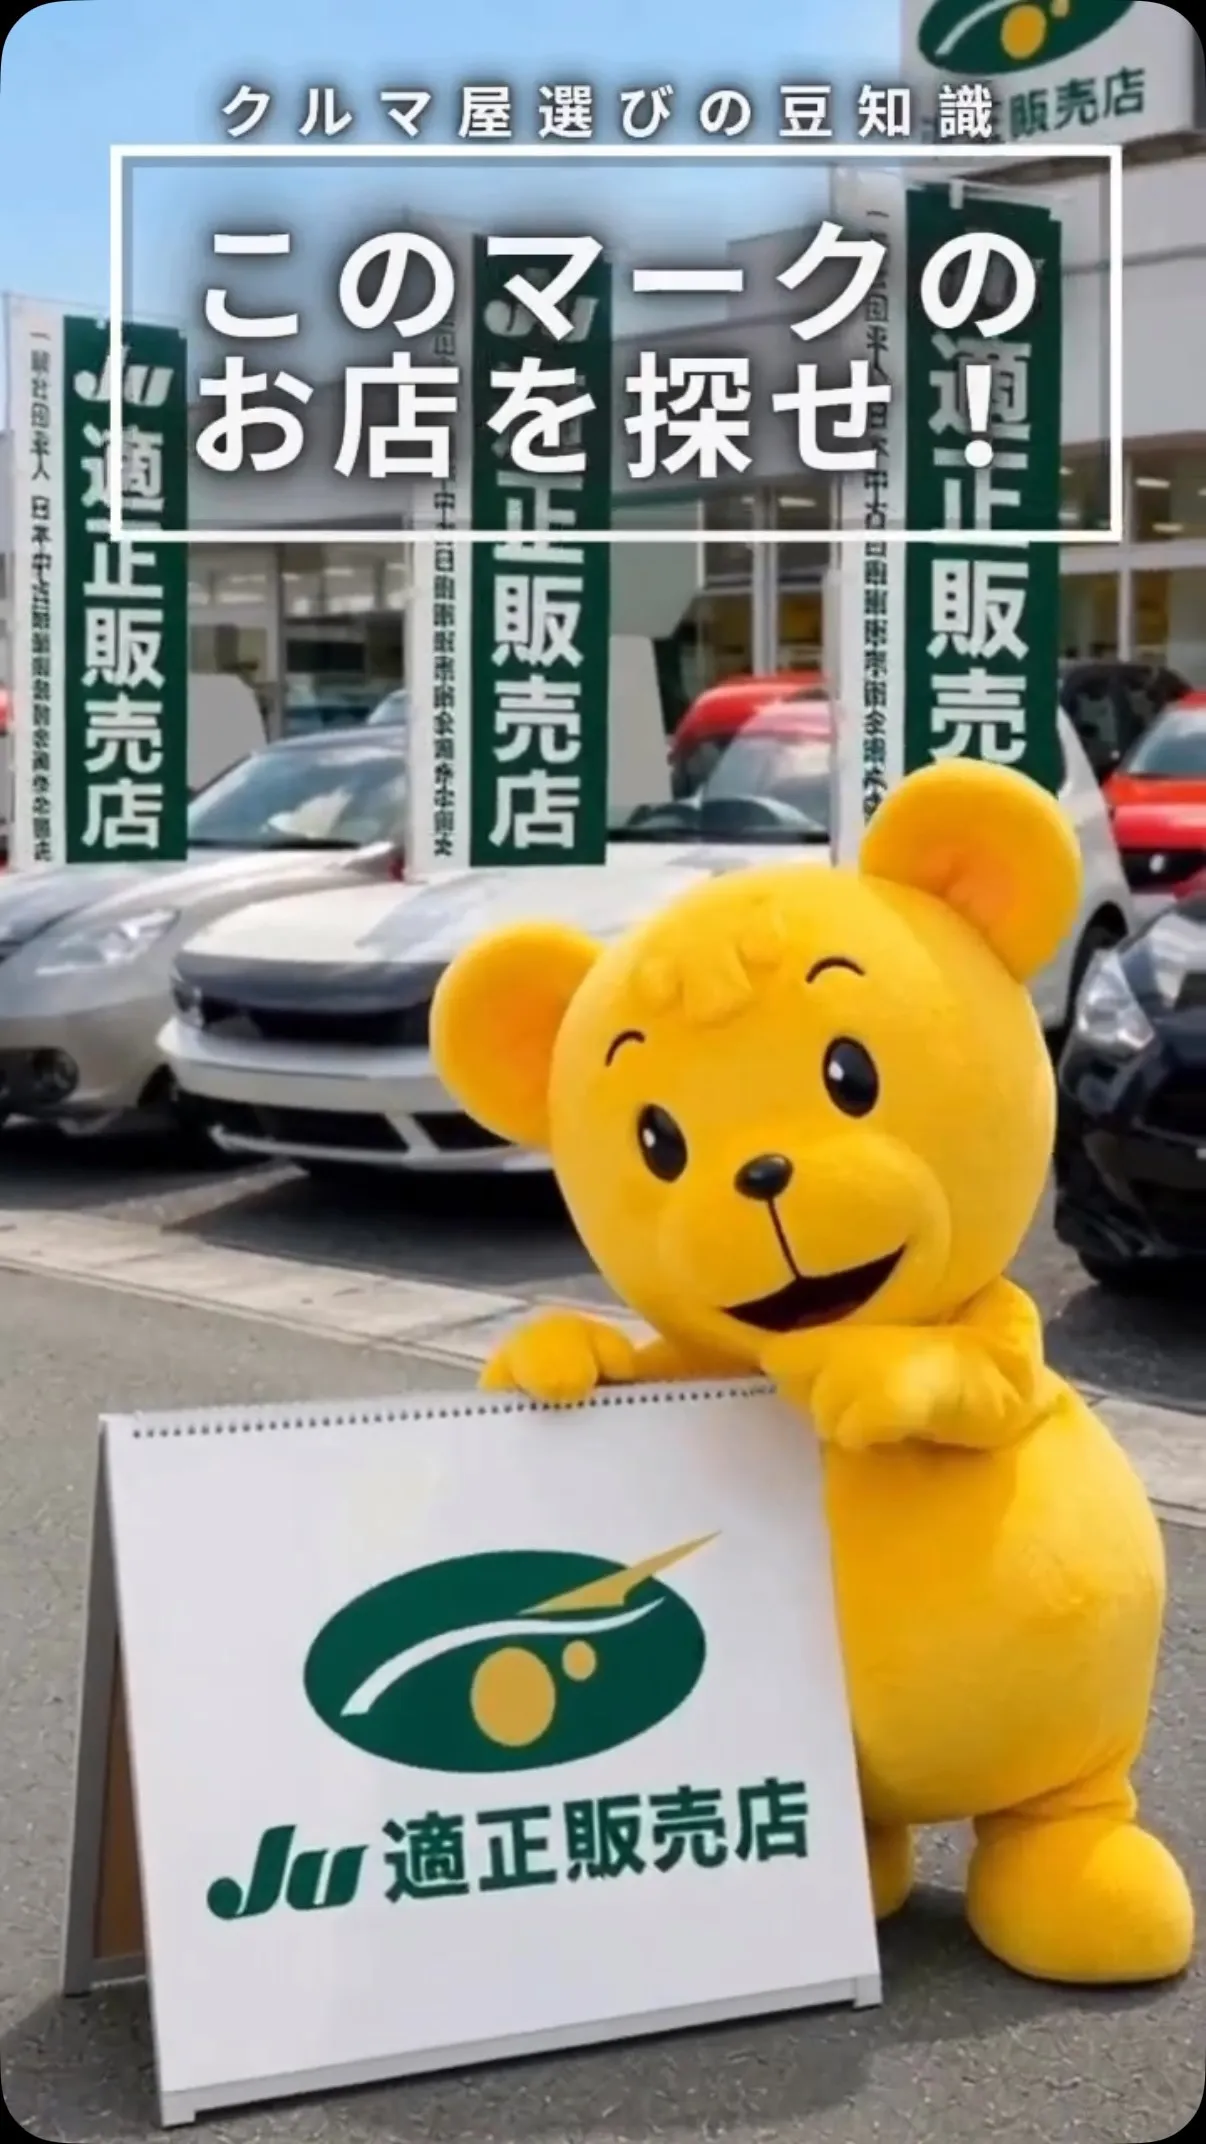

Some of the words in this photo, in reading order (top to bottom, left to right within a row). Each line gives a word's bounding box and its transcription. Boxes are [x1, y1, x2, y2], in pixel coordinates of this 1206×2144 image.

[81, 422, 166, 848] 適正販売店
[382, 1777, 809, 1903] 適正販売店
